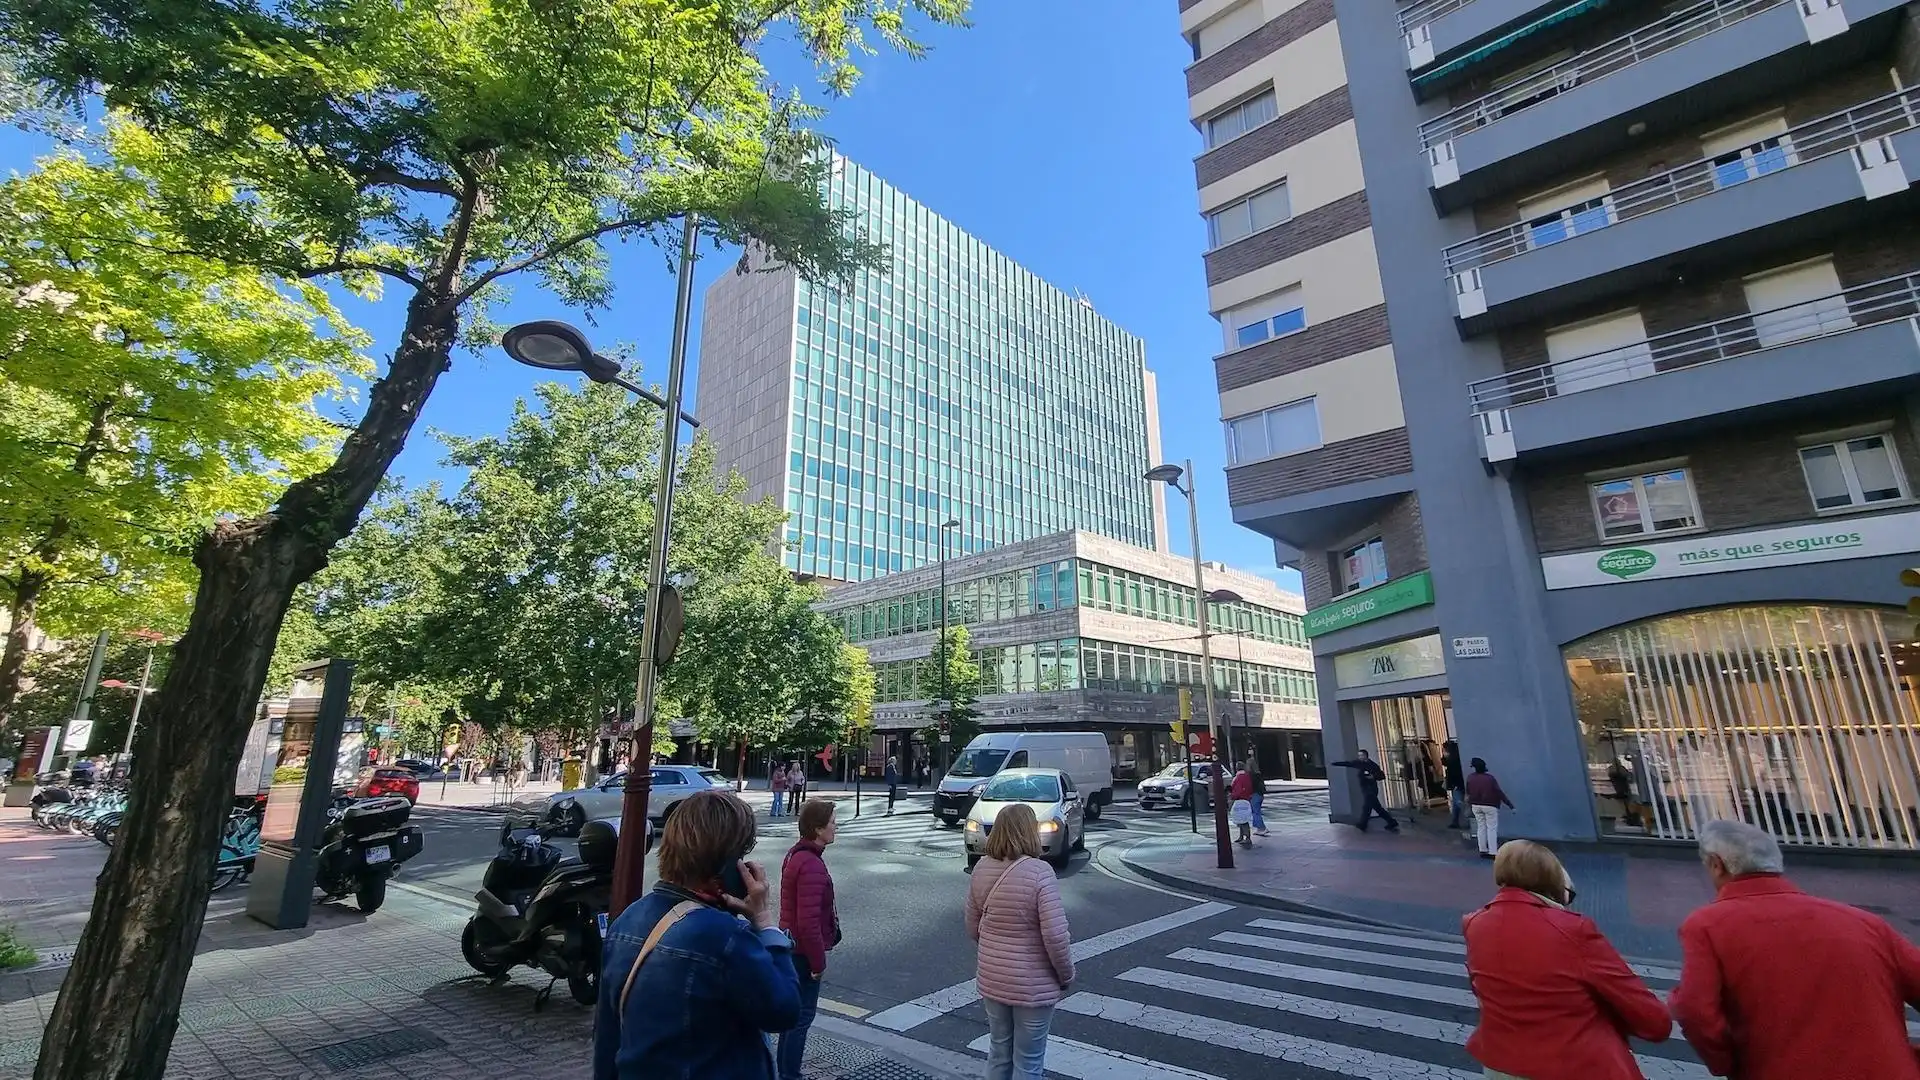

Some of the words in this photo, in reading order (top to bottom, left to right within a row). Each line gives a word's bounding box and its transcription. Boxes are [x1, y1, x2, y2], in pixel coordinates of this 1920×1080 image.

[1678, 548, 1719, 562] más
[1725, 542, 1764, 559] que
[1771, 532, 1861, 552] seguros
[1601, 556, 1652, 570] seguros
[1341, 598, 1375, 618] seguros
[1456, 648, 1467, 656] LAS
[1468, 647, 1489, 655] DAMAS
[1371, 655, 1396, 674] ZARA
